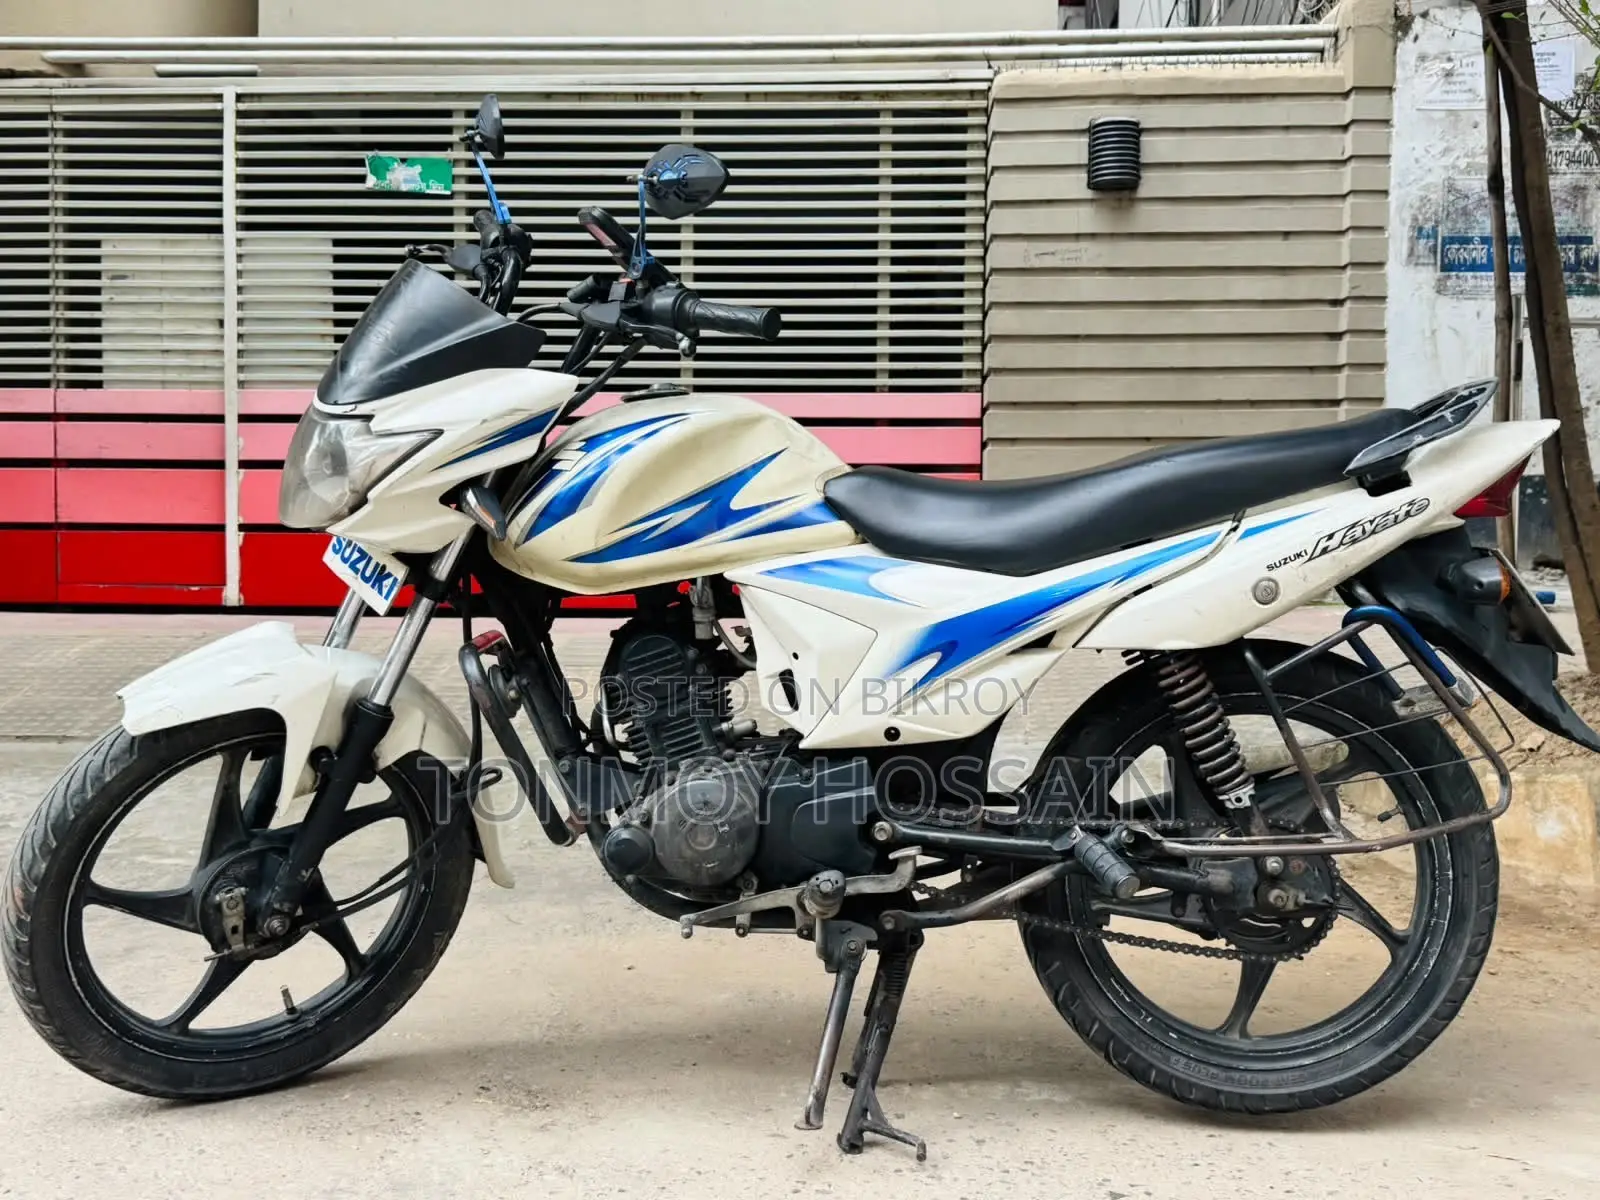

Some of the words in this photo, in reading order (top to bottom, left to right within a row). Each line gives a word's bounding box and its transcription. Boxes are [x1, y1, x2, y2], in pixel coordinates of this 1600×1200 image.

[331, 535, 399, 601] SUZUKI
[1266, 549, 1308, 571] SUZUKI
[1302, 497, 1431, 565] Hayate
